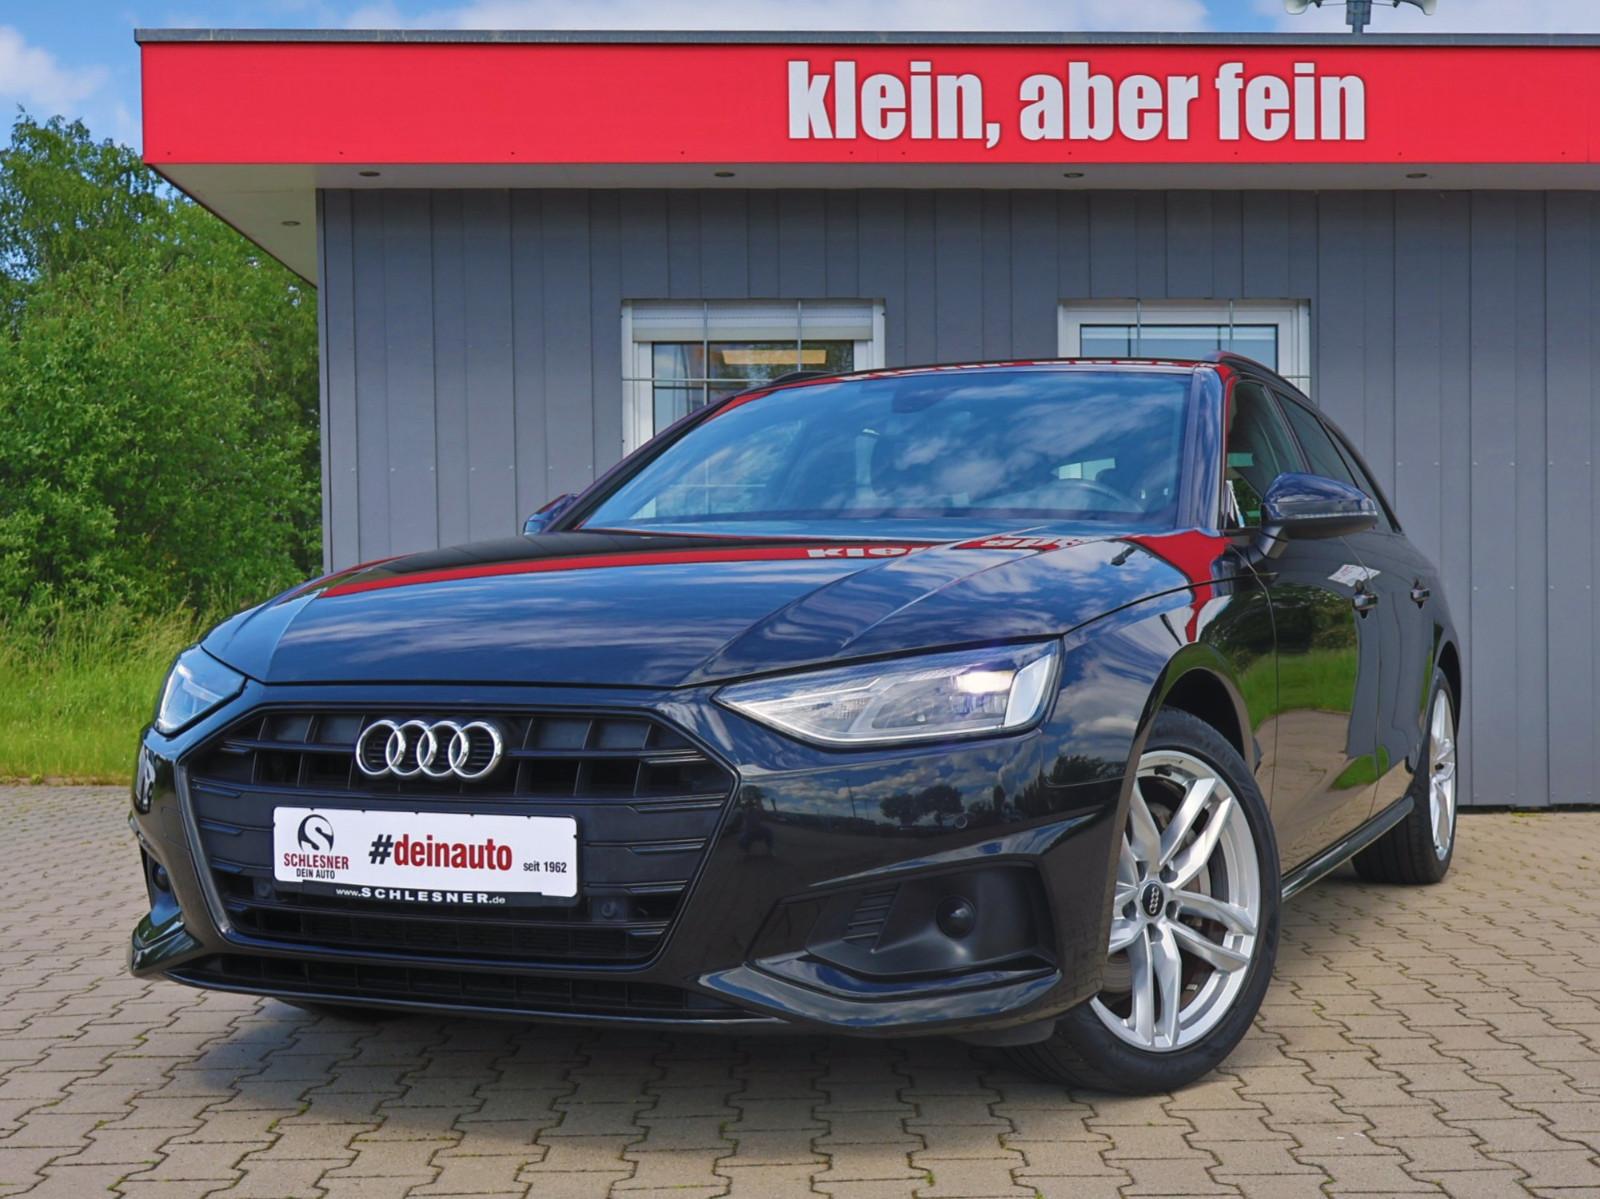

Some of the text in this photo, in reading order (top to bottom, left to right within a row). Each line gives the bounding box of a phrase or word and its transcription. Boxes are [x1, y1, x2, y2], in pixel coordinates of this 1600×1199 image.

[788, 60, 1366, 149] klein, aber fein
[369, 833, 512, 871] #deinauto
[283, 852, 349, 870] SCHLESNER
[523, 860, 567, 873] seit 1962
[296, 868, 336, 880] DEIN AUTO
[336, 887, 506, 904] www.SCHLESNER.de
